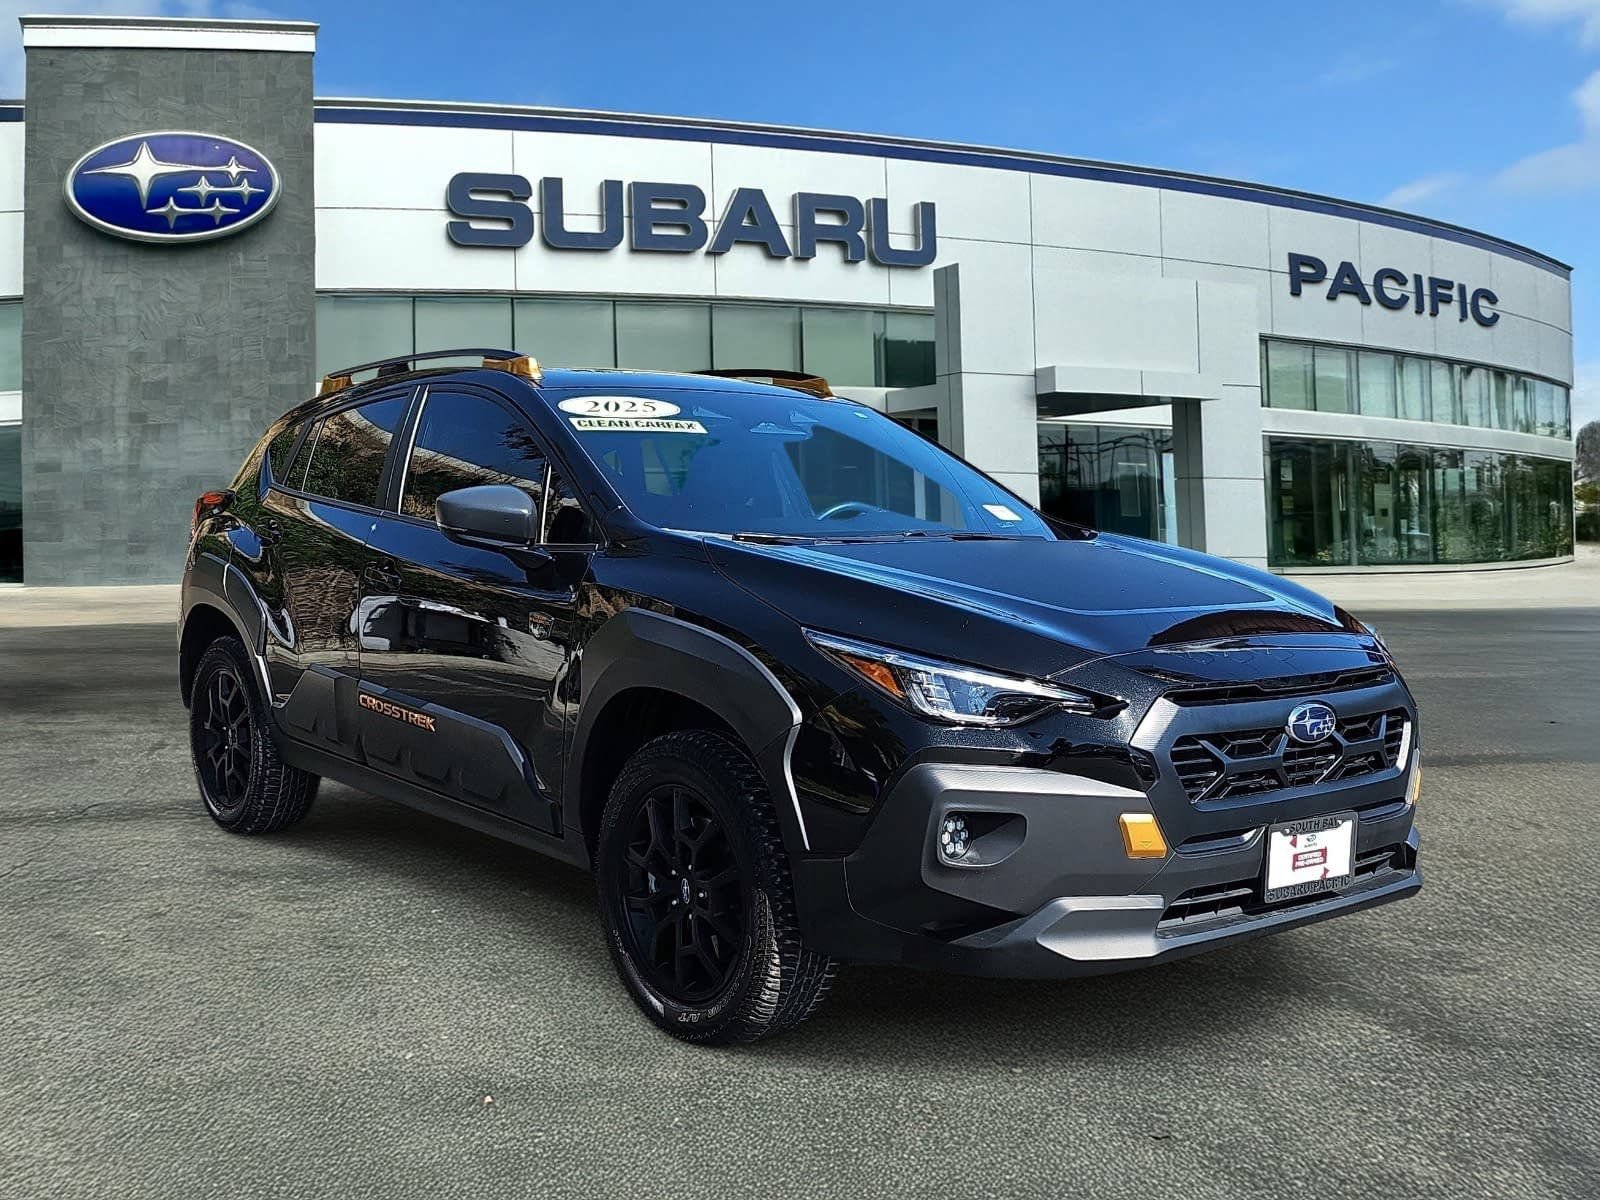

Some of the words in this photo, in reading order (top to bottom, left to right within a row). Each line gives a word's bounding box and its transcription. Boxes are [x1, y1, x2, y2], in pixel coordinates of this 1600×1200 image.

[446, 172, 937, 268] SUBARU
[1288, 252, 1501, 328] PACIFIC
[587, 400, 657, 413] 2025
[577, 419, 631, 429] CLEAN
[634, 419, 698, 431] CARFAX
[358, 693, 437, 733] CROSSTREK
[1289, 819, 1321, 834] SOUTH
